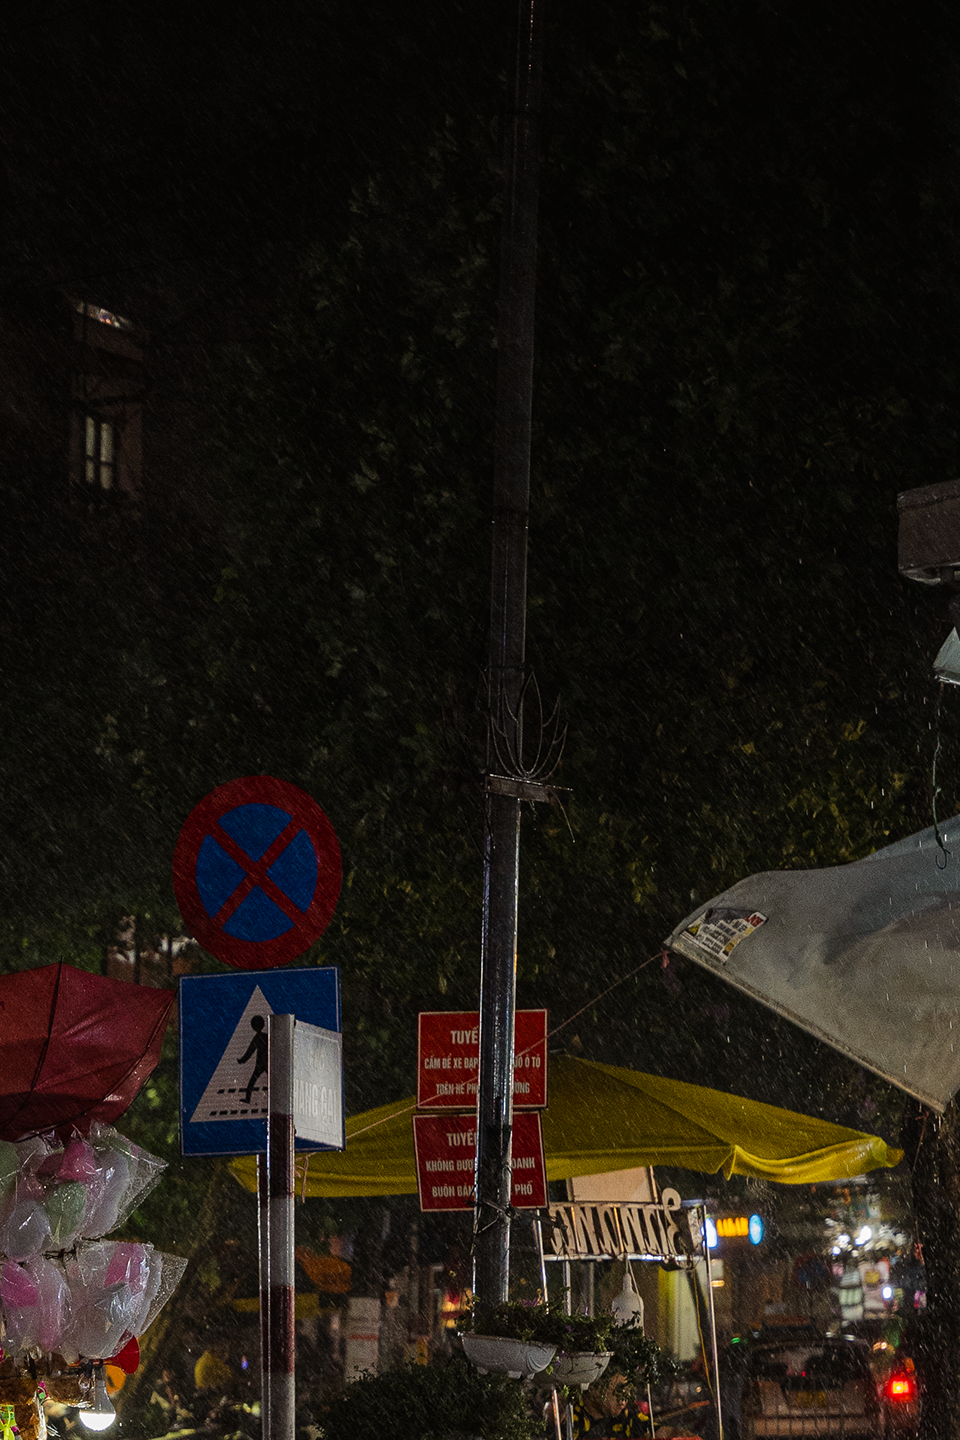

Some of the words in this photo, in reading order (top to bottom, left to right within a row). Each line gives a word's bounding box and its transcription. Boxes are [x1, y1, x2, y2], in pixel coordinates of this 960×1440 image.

[450, 1025, 479, 1045] TUYẾ
[453, 1057, 462, 1069] XE
[466, 1082, 478, 1095] PH
[425, 1157, 455, 1172] KHÔNG
[456, 1158, 474, 1173] ĐƯỢ
[511, 1157, 536, 1170] OANH
[431, 1182, 456, 1197] BUÔN
[514, 1180, 534, 1196] PHỐ
